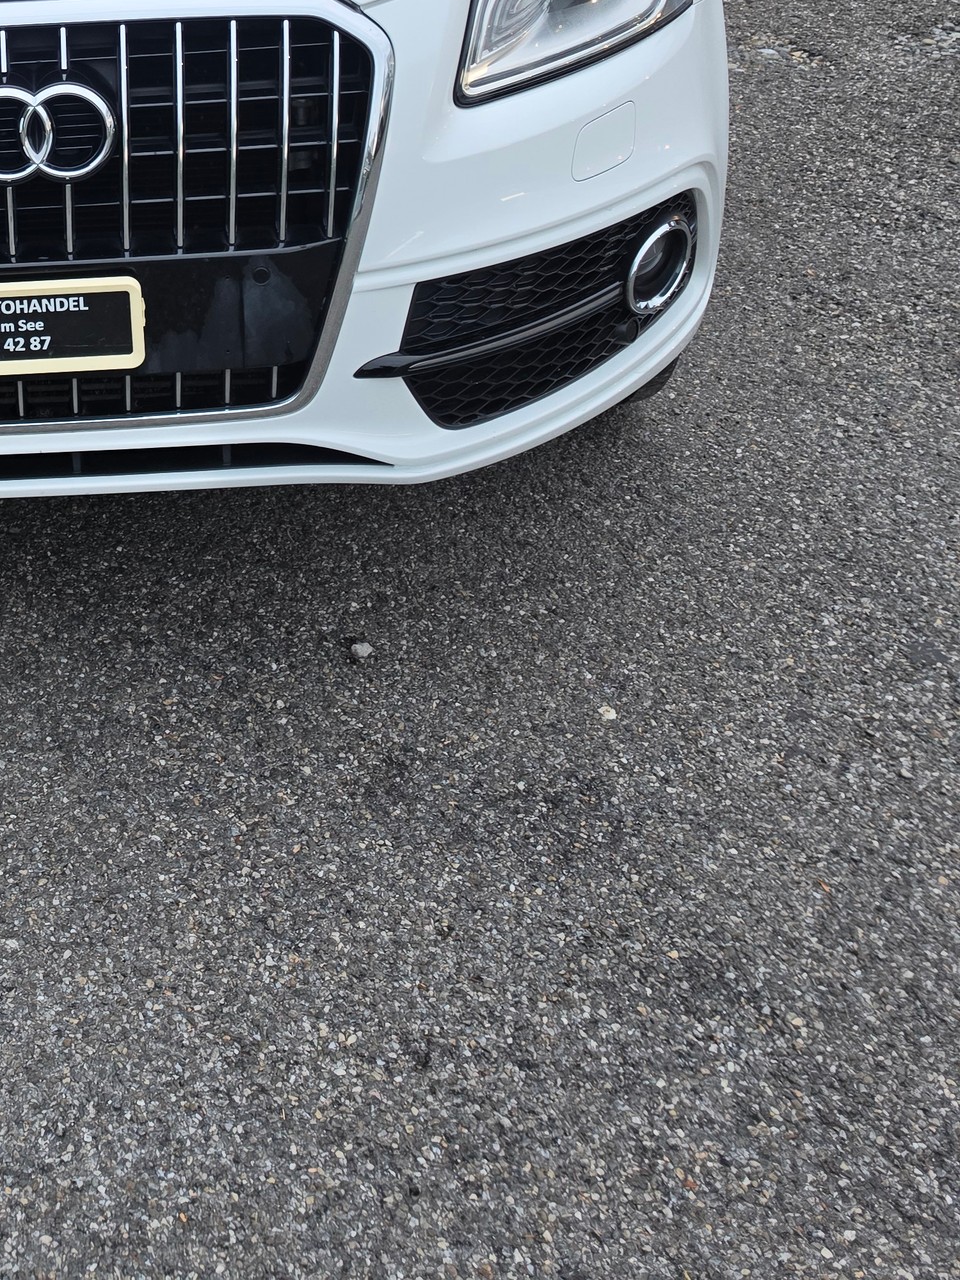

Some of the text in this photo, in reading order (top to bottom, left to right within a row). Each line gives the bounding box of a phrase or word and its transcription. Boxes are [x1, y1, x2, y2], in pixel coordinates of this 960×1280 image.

[17, 319, 45, 332] See
[3, 336, 26, 352] 42
[29, 335, 52, 351] 87
